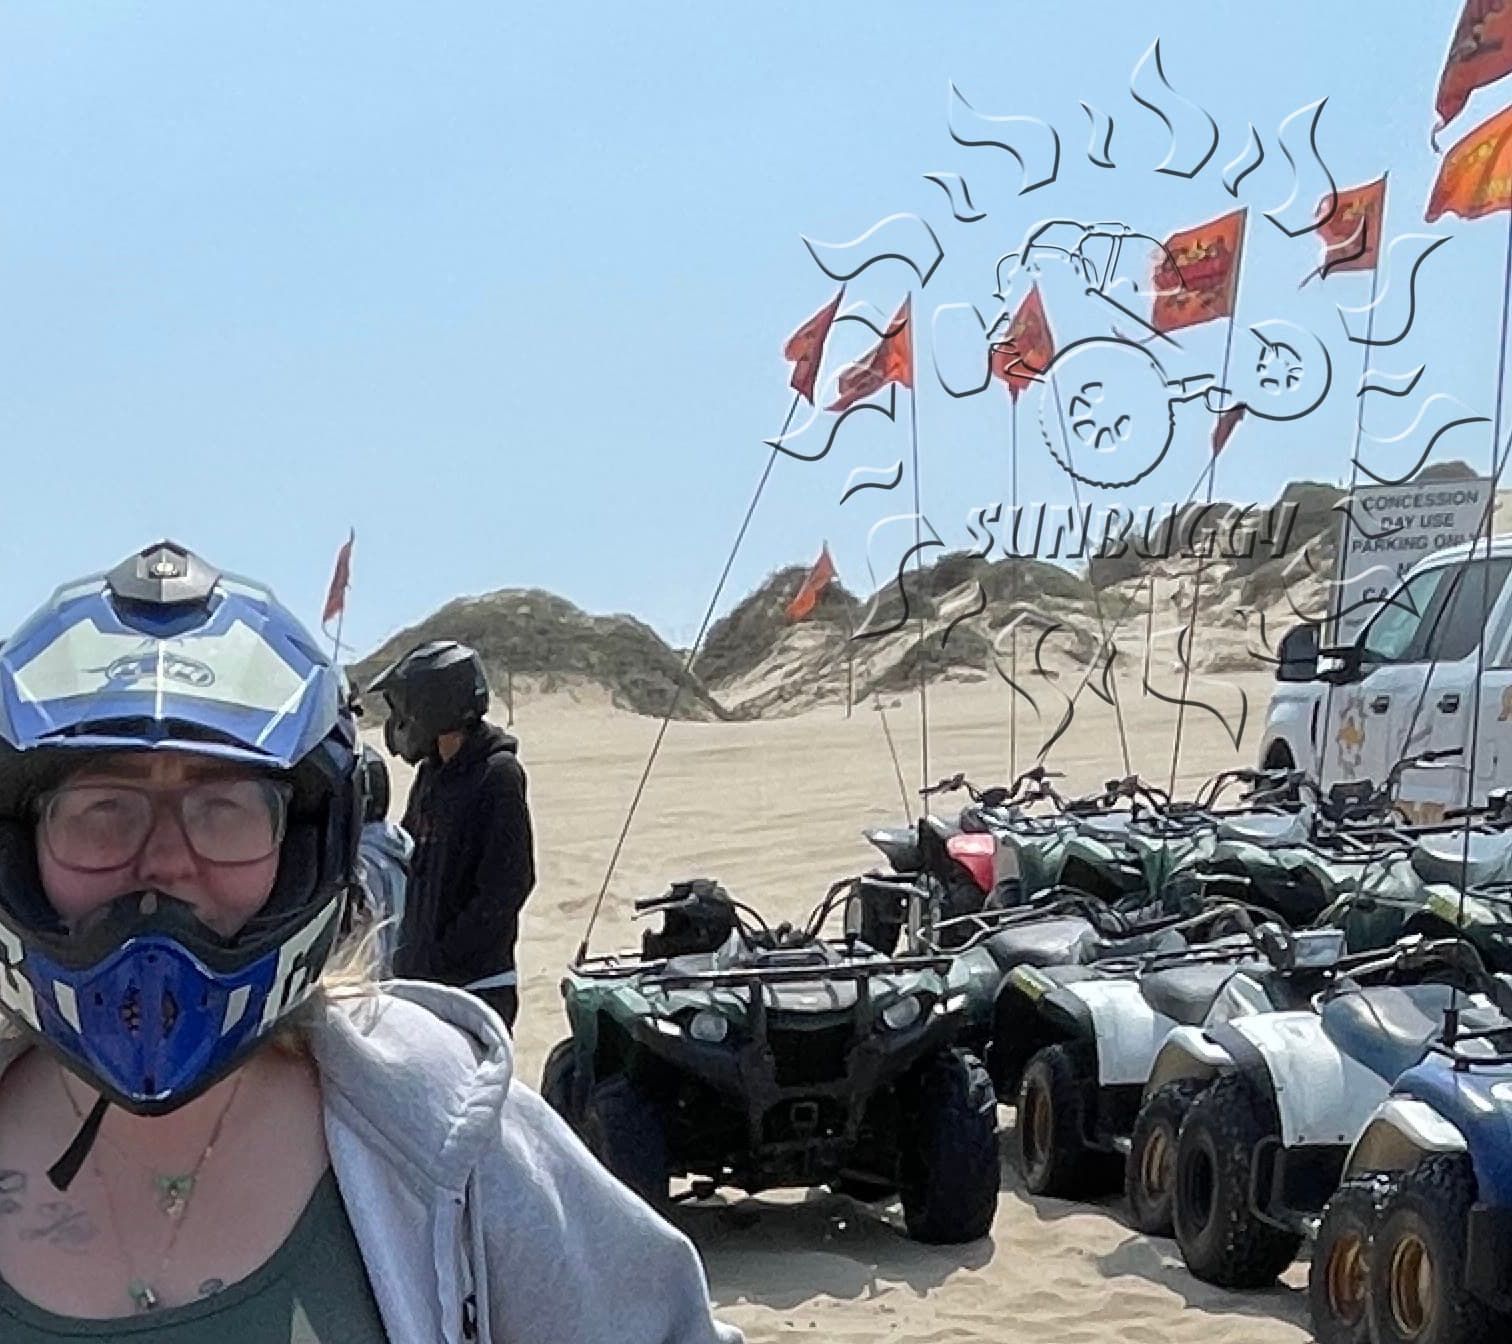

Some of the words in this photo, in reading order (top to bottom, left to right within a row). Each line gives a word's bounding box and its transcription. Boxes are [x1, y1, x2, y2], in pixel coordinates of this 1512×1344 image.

[1361, 490, 1479, 512] CONCESSION
[1380, 515, 1415, 531] DAY
[1420, 513, 1455, 528] USE
[1352, 534, 1429, 553] PARKING
